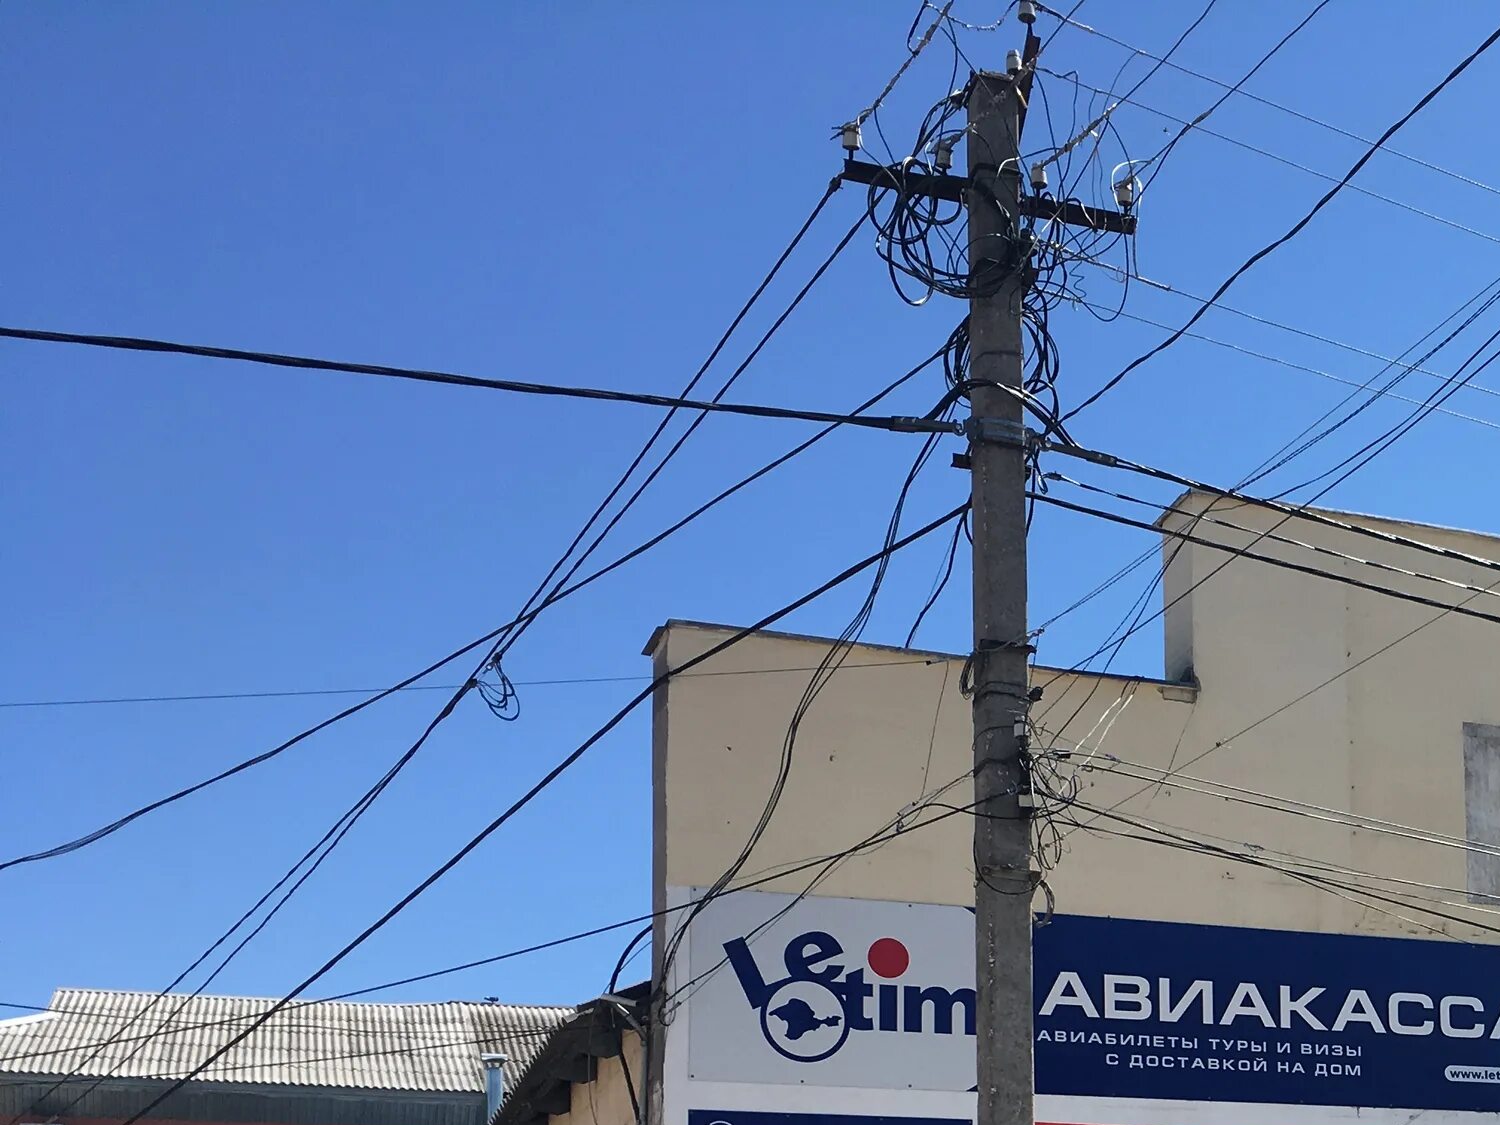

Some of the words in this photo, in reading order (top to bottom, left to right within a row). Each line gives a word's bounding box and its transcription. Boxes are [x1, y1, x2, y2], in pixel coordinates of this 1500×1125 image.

[1037, 1030, 1199, 1049] АВИАБИЛЕТЫ
[1209, 1038, 1267, 1053] ТУРЫ
[1277, 1042, 1291, 1054] И
[1300, 1043, 1363, 1057] ВИЗЫ
[1106, 1054, 1119, 1066] С
[1129, 1055, 1267, 1073] ДОСТАВКОЙ
[1277, 1061, 1305, 1075] НА
[1314, 1064, 1362, 1078] ДОМ
